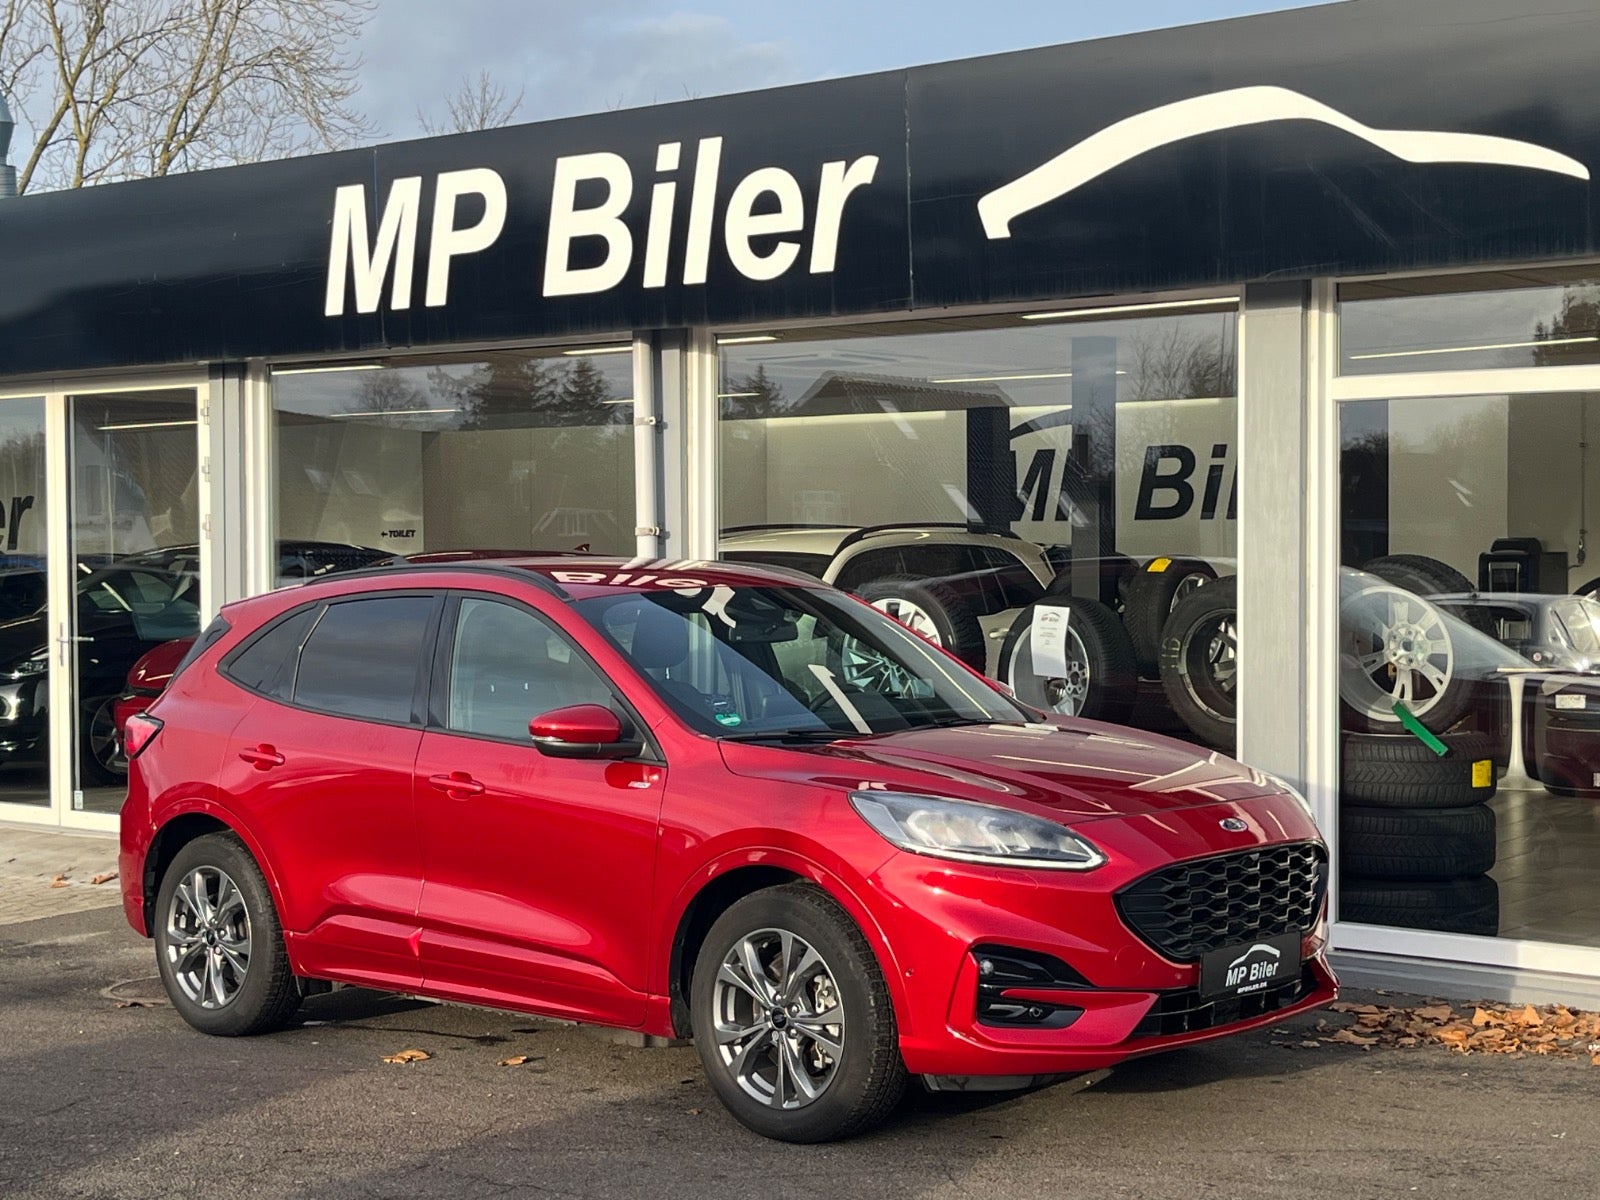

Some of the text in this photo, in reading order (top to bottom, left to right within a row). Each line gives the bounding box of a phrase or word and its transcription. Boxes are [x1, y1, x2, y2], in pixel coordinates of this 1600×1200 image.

[324, 136, 880, 316] MP Biler
[0, 495, 35, 554] r
[388, 529, 417, 538] TOILET
[1225, 961, 1279, 987] MP Biler
